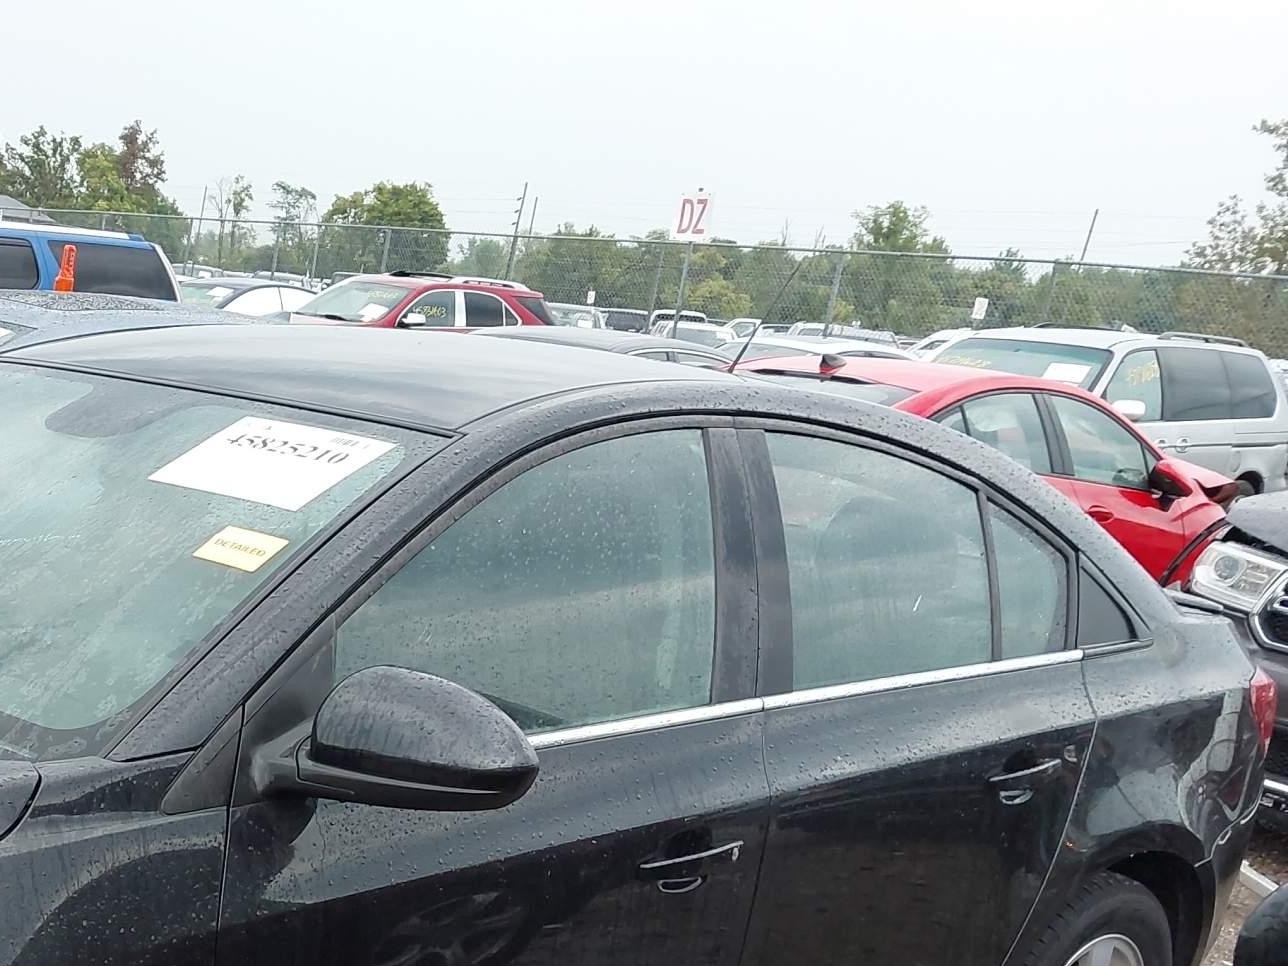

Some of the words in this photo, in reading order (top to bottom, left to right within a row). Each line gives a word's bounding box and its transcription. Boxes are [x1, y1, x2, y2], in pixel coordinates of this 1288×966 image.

[676, 198, 708, 234] DZ
[226, 433, 350, 464] 45825210
[213, 537, 267, 558] DETAILED
